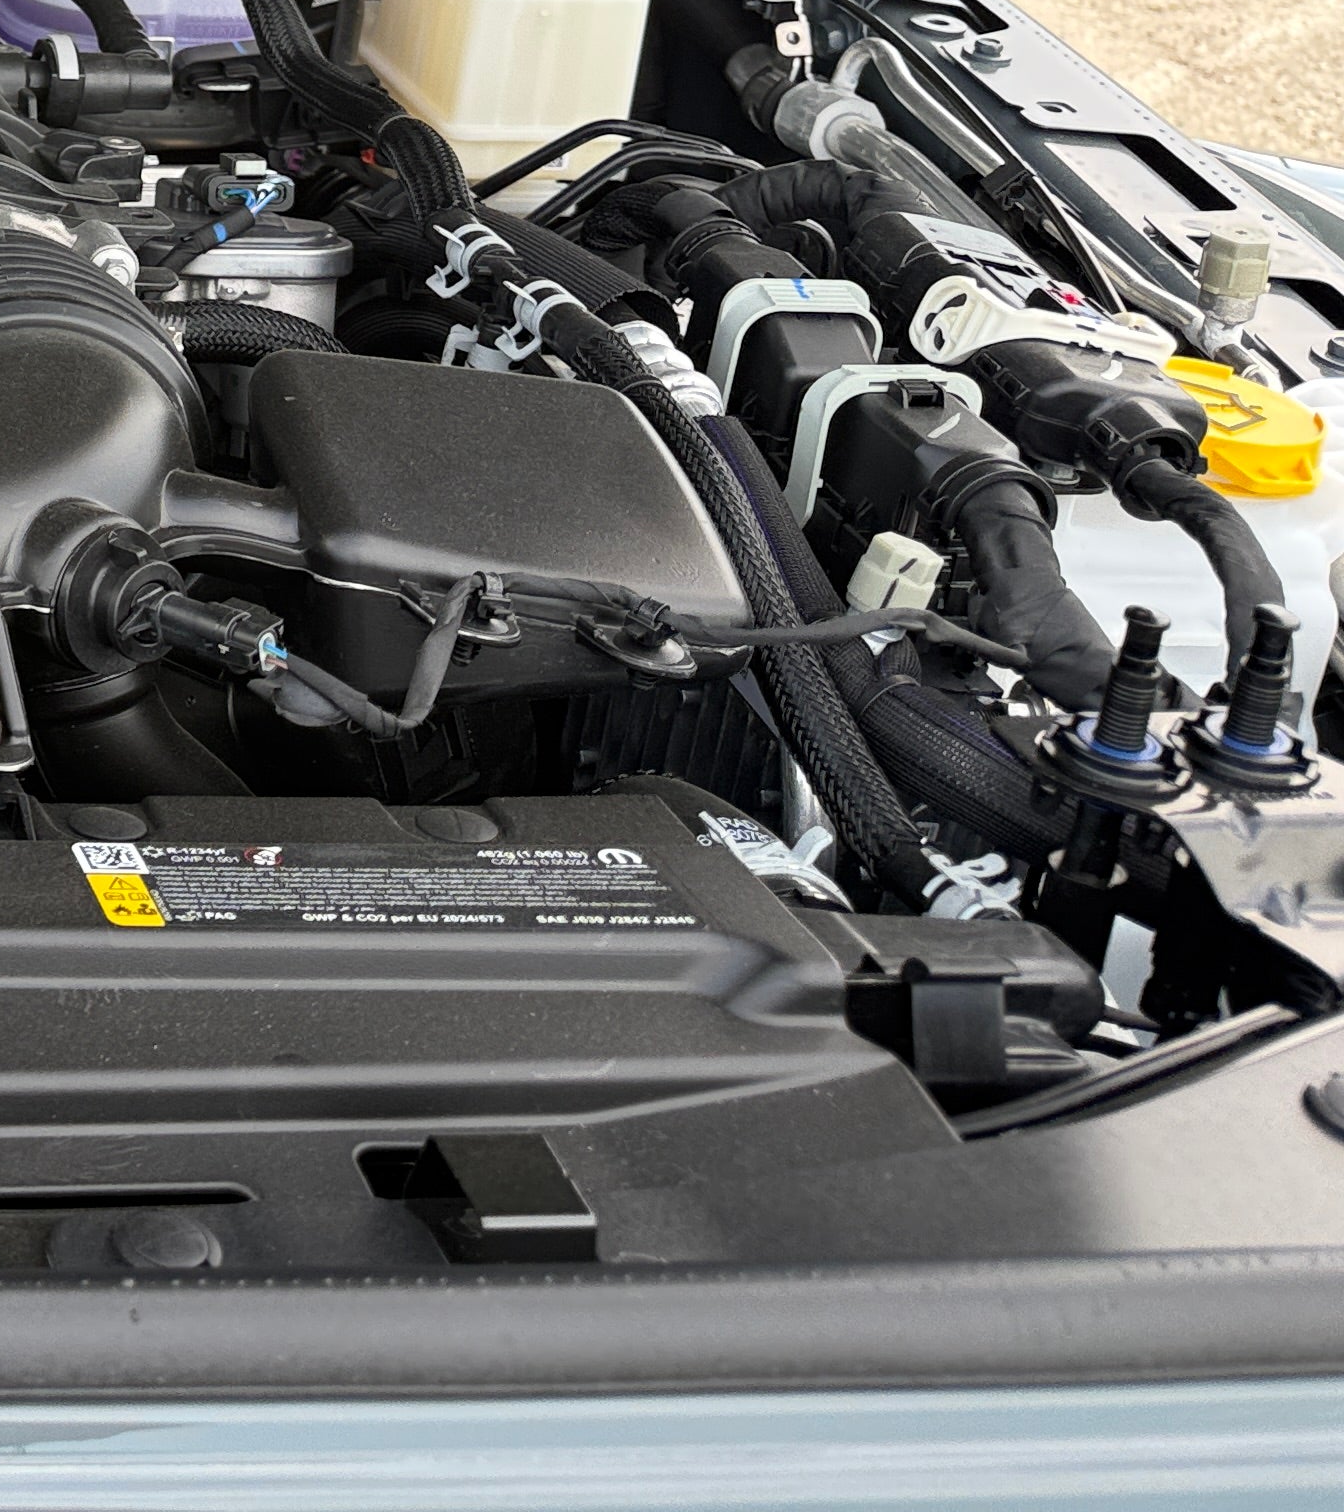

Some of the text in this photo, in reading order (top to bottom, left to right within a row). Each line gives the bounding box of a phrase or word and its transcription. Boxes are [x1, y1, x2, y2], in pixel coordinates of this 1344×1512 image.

[716, 816, 759, 831] RAD
[204, 911, 237, 921] PAG
[302, 913, 338, 922] GWP
[341, 913, 354, 922] &
[356, 913, 388, 923] CO2
[391, 915, 413, 925] per
[416, 914, 439, 923] EU
[536, 915, 569, 924] SAE
